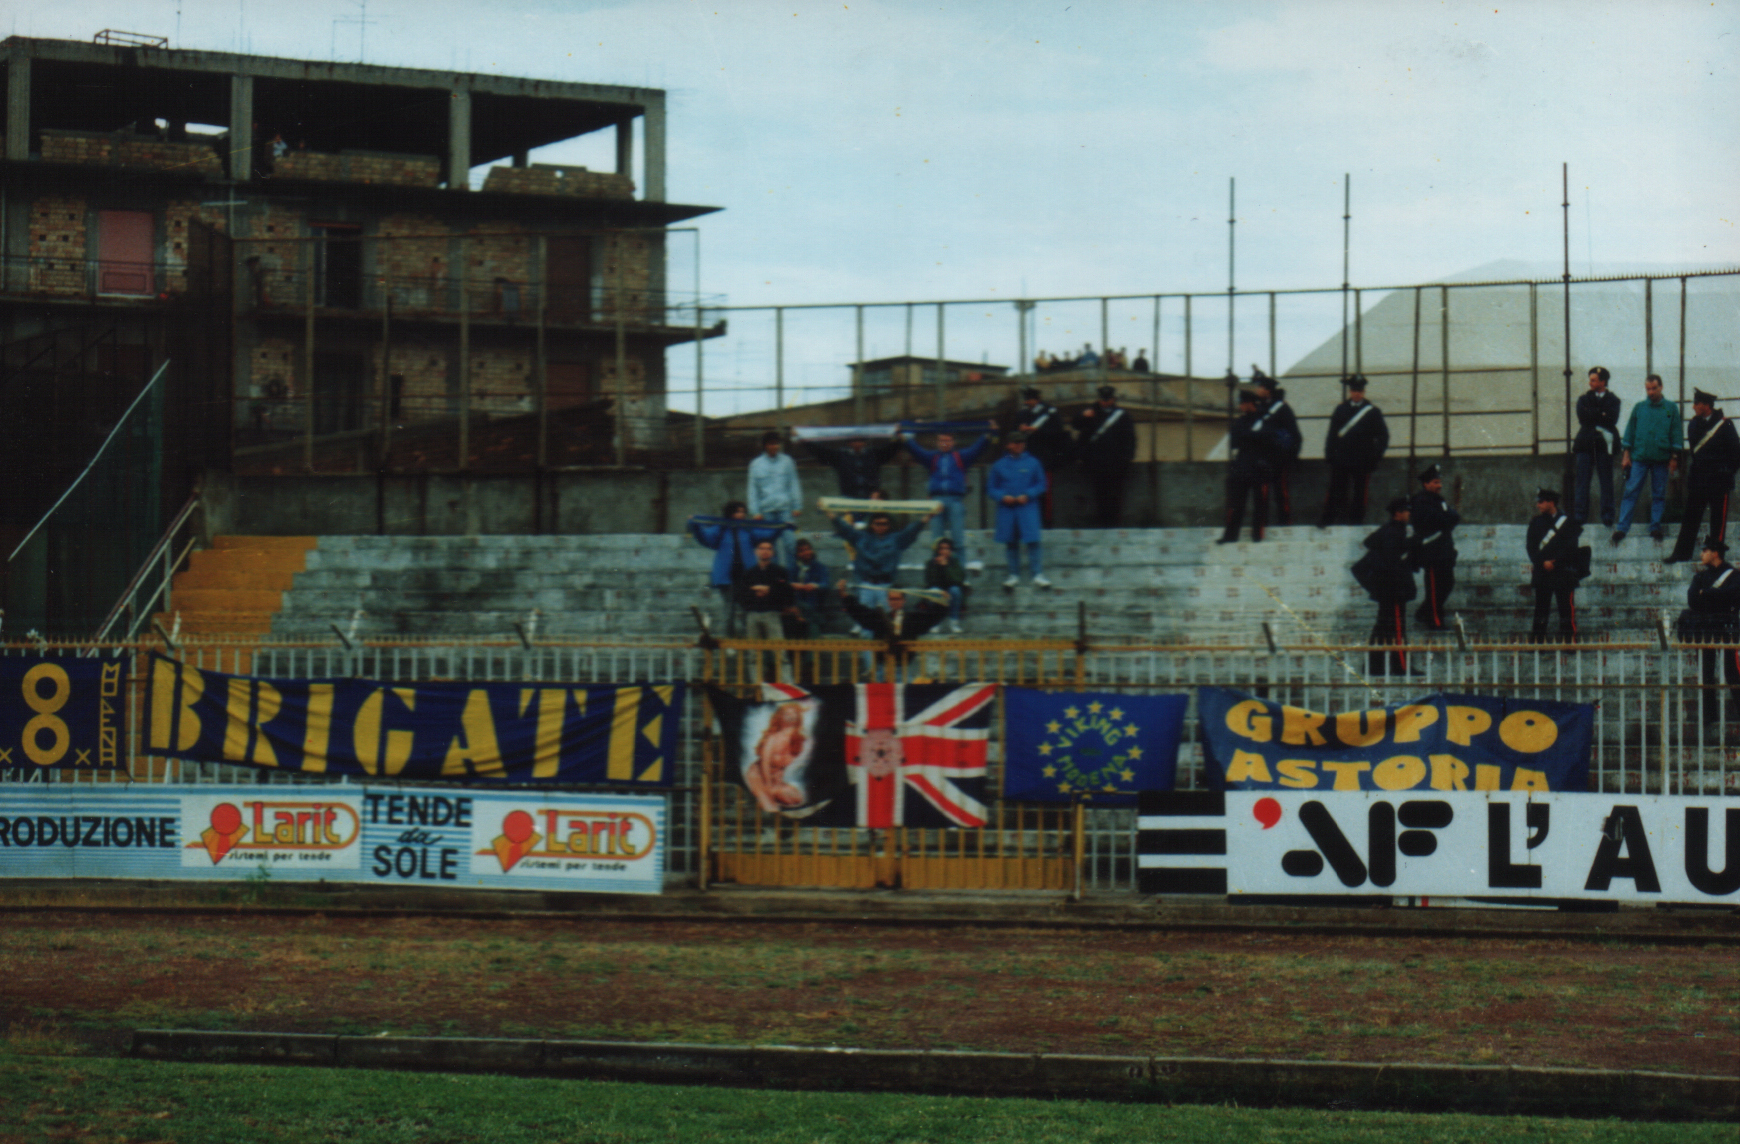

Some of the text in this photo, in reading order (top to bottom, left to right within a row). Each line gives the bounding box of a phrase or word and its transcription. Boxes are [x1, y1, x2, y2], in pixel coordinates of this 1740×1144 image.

[150, 657, 675, 782] BRIGATE
[1057, 714, 1123, 746] VIKING
[1225, 699, 1559, 753] GRUPPO
[1225, 748, 1550, 792] ASTORIA
[252, 801, 341, 845] Larit
[366, 793, 472, 828] TENDE
[547, 808, 637, 856] Larit
[273, 852, 294, 863] per
[372, 845, 459, 880] SOLE
